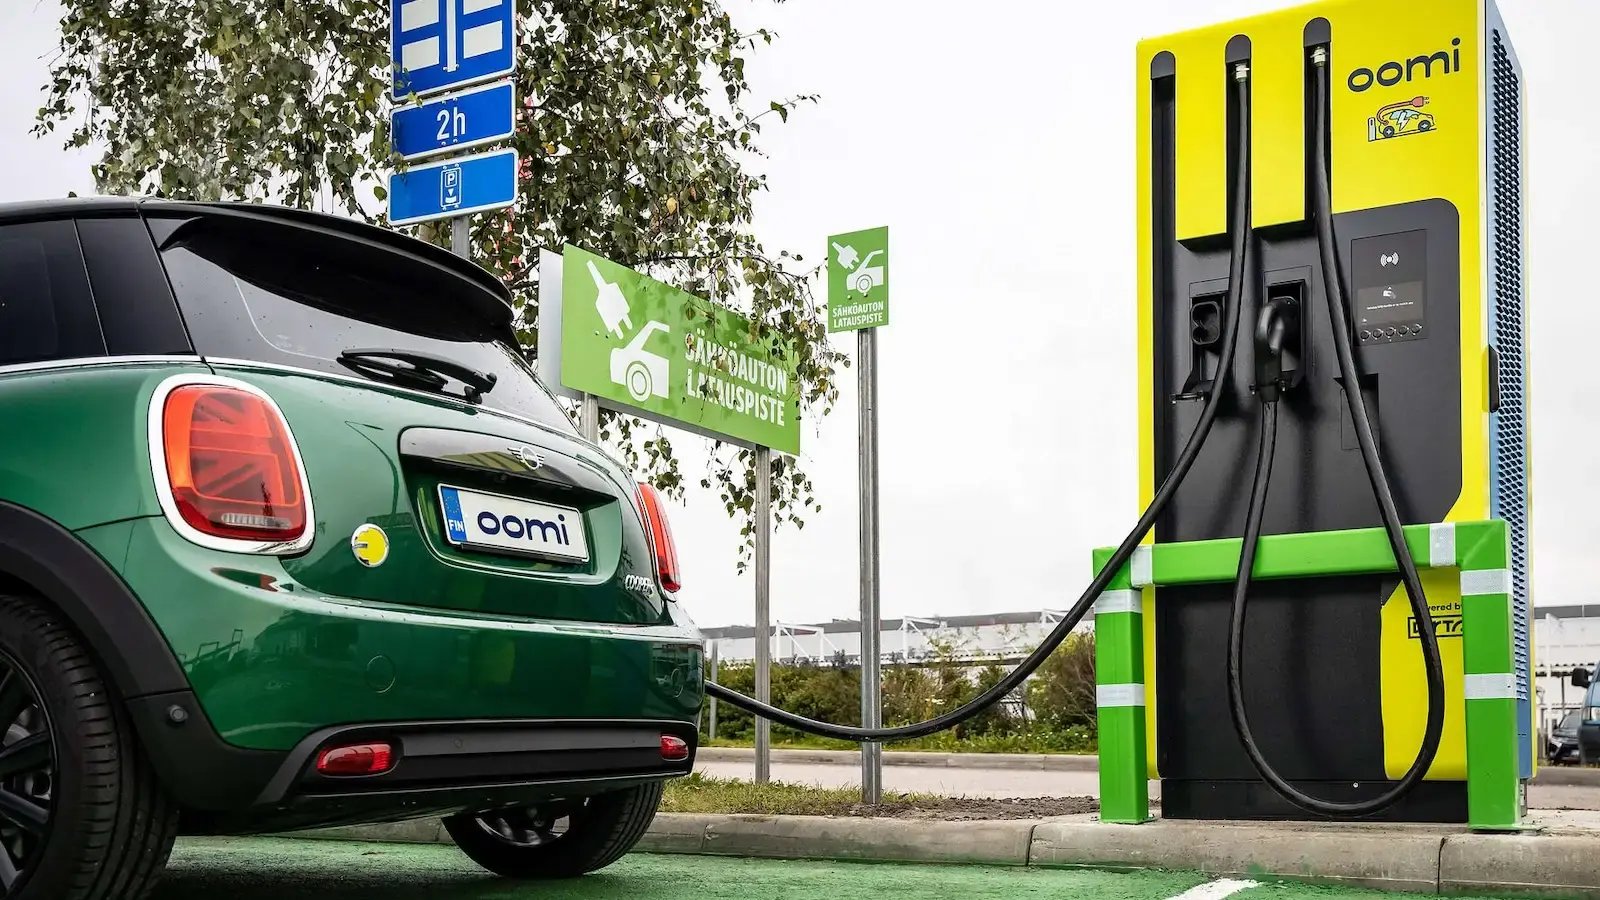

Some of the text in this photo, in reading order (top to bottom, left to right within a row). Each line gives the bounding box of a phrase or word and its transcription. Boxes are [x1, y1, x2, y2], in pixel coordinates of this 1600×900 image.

[1347, 37, 1460, 92] oomi
[447, 172, 455, 186] P
[832, 301, 884, 318] SÄHKÖAUTON
[833, 312, 883, 328] LATAUSPISTE
[448, 519, 464, 533] FIN
[477, 511, 569, 546] oomi
